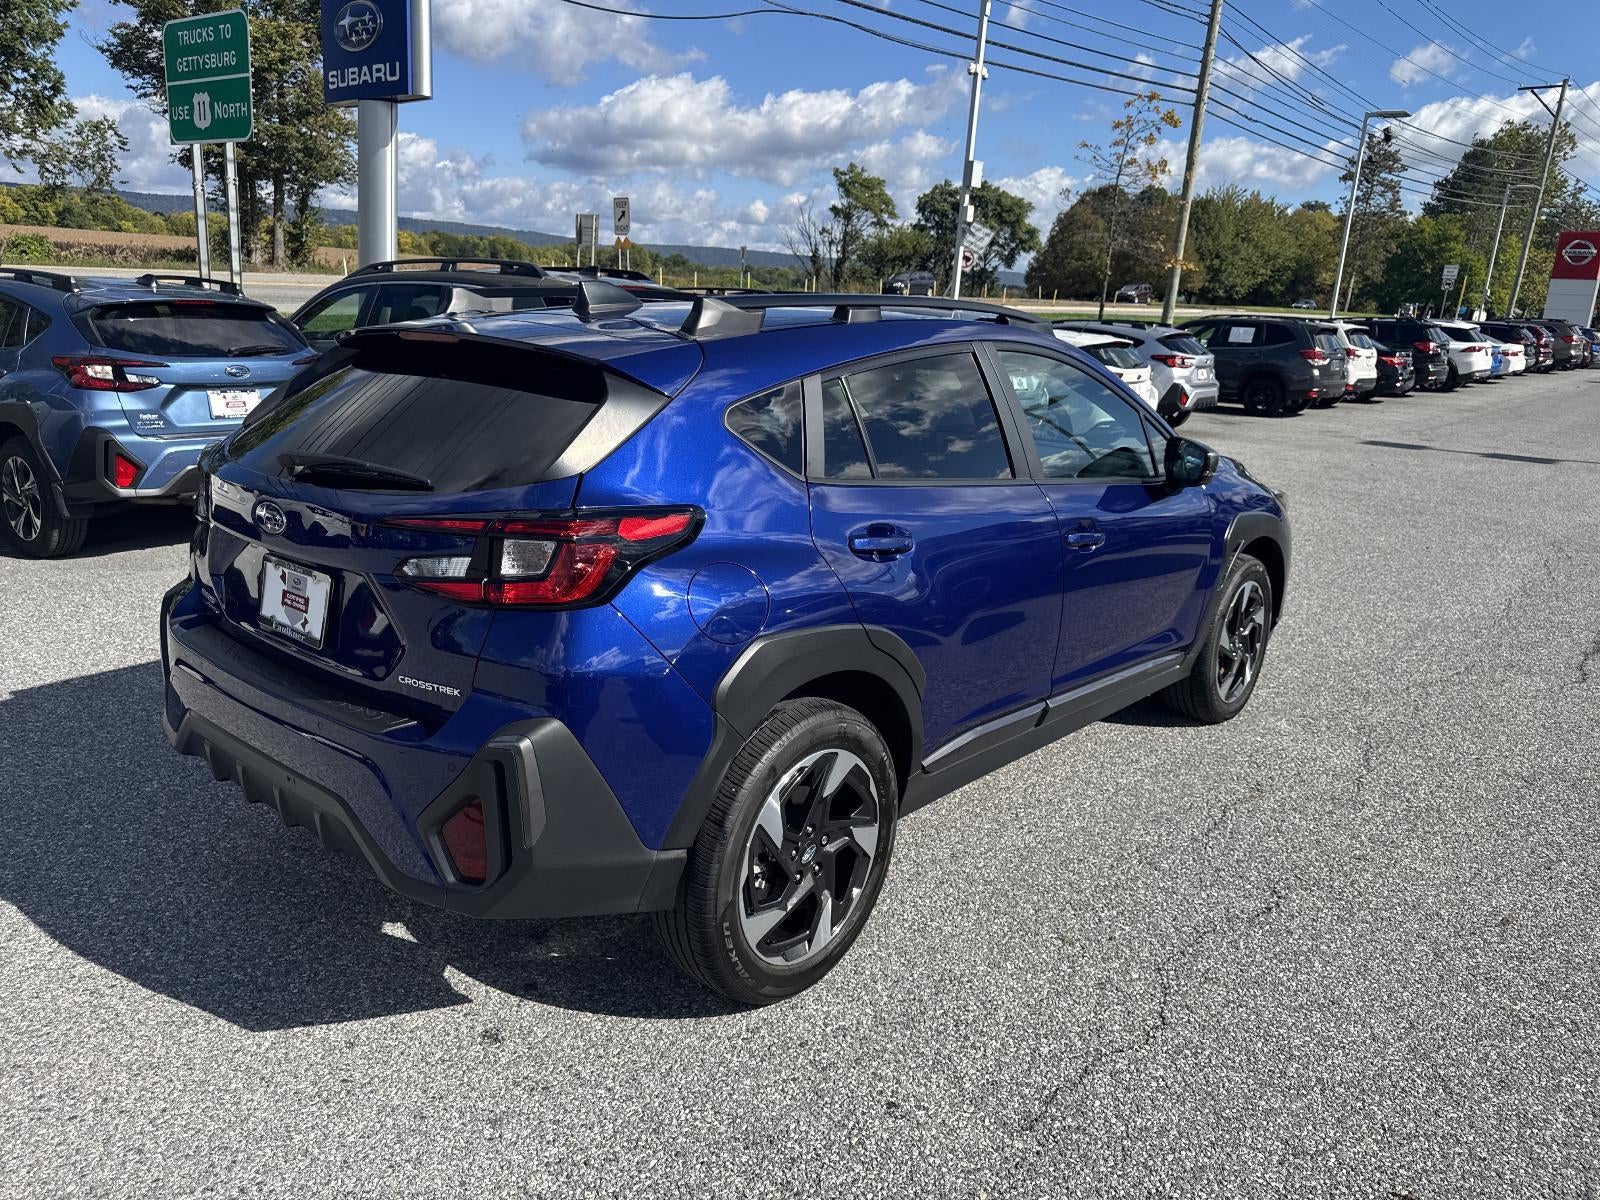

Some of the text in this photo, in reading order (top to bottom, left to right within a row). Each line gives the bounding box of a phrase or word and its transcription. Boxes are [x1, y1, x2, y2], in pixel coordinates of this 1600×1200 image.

[178, 23, 232, 46] TRUCKS TO
[176, 50, 237, 72] GETTYSBURG
[328, 61, 400, 90] SUBARU
[172, 105, 191, 121] USE
[197, 100, 207, 121] 11
[272, 620, 306, 641] Faulkner
[398, 675, 461, 697] CROSSTREK
